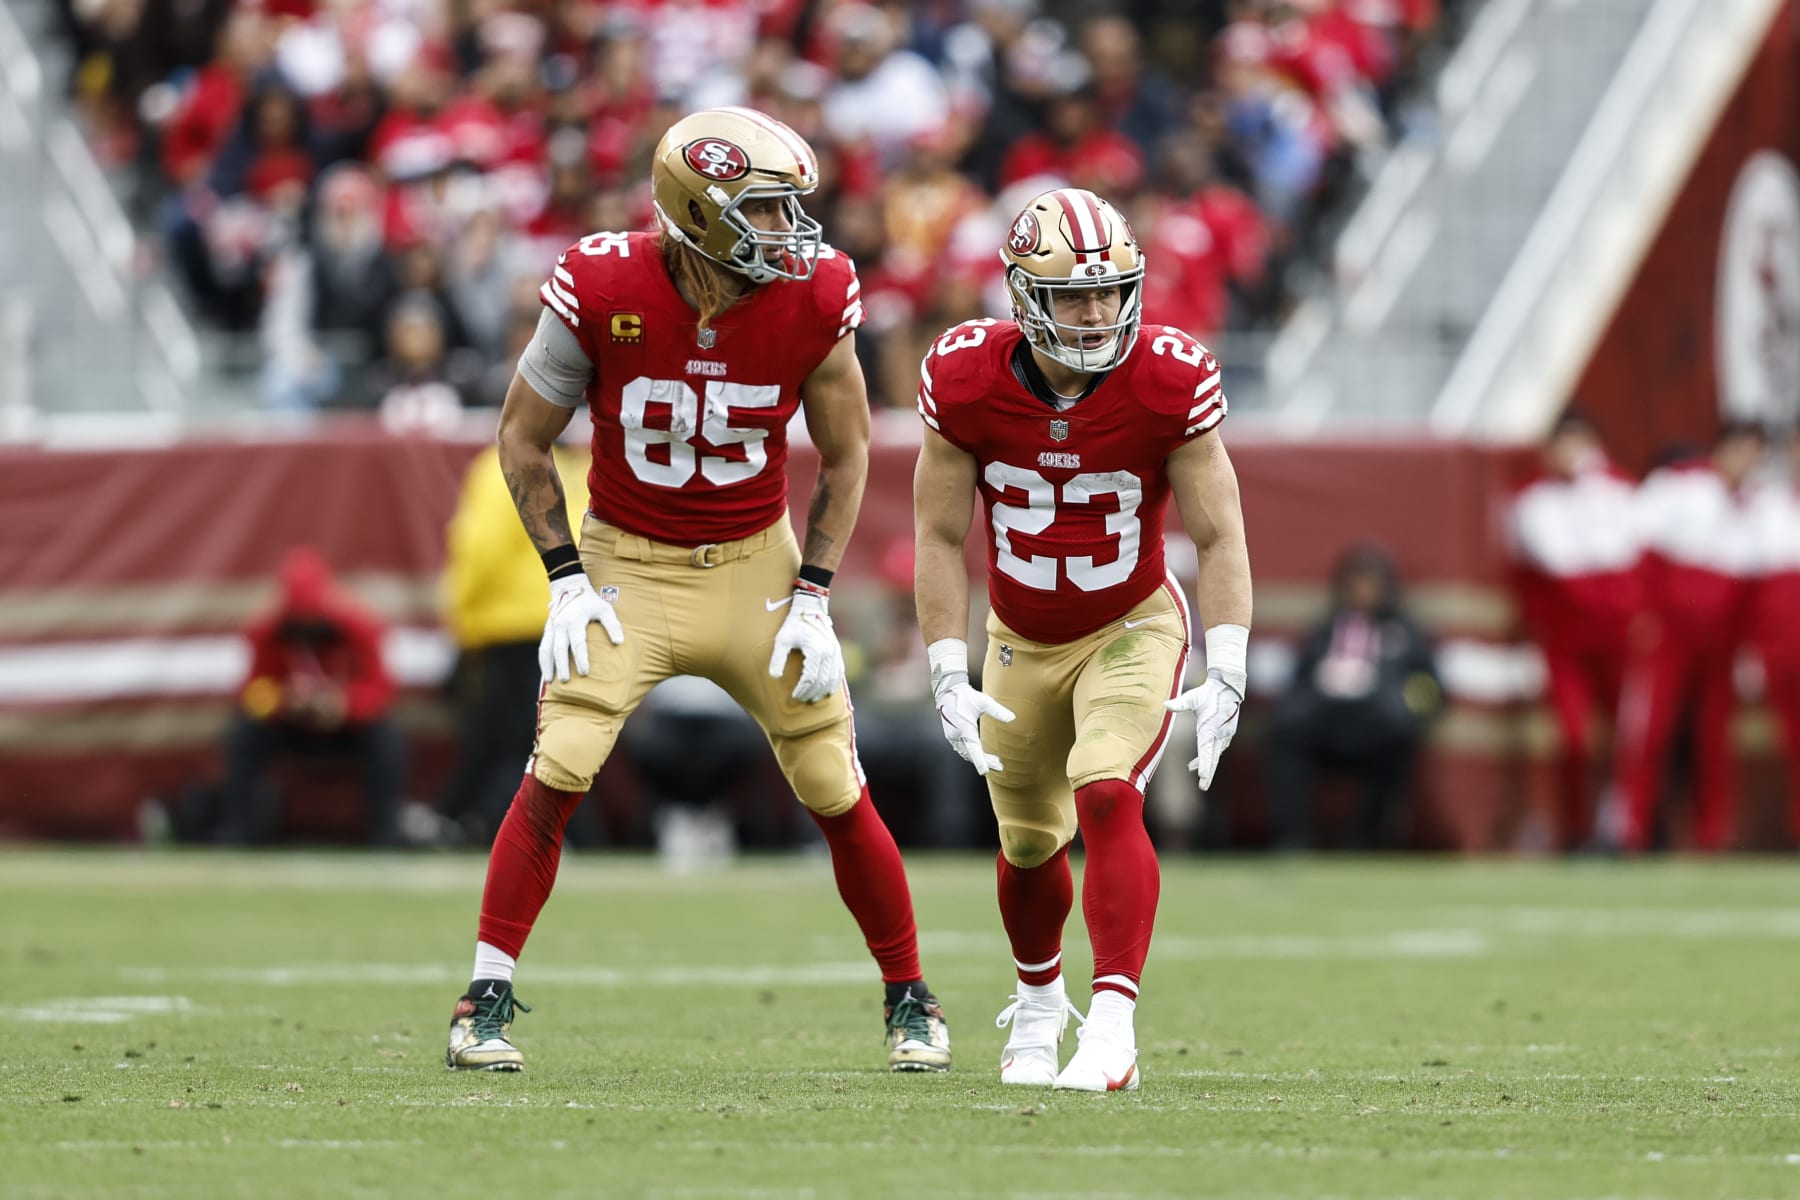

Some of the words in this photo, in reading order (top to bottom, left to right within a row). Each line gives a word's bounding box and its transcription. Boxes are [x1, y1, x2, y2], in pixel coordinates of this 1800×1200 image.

[699, 142, 739, 177] SF
[611, 314, 641, 337] C
[620, 376, 781, 488] 85
[1037, 451, 1081, 469] 49ERS
[984, 460, 1143, 592] 23
